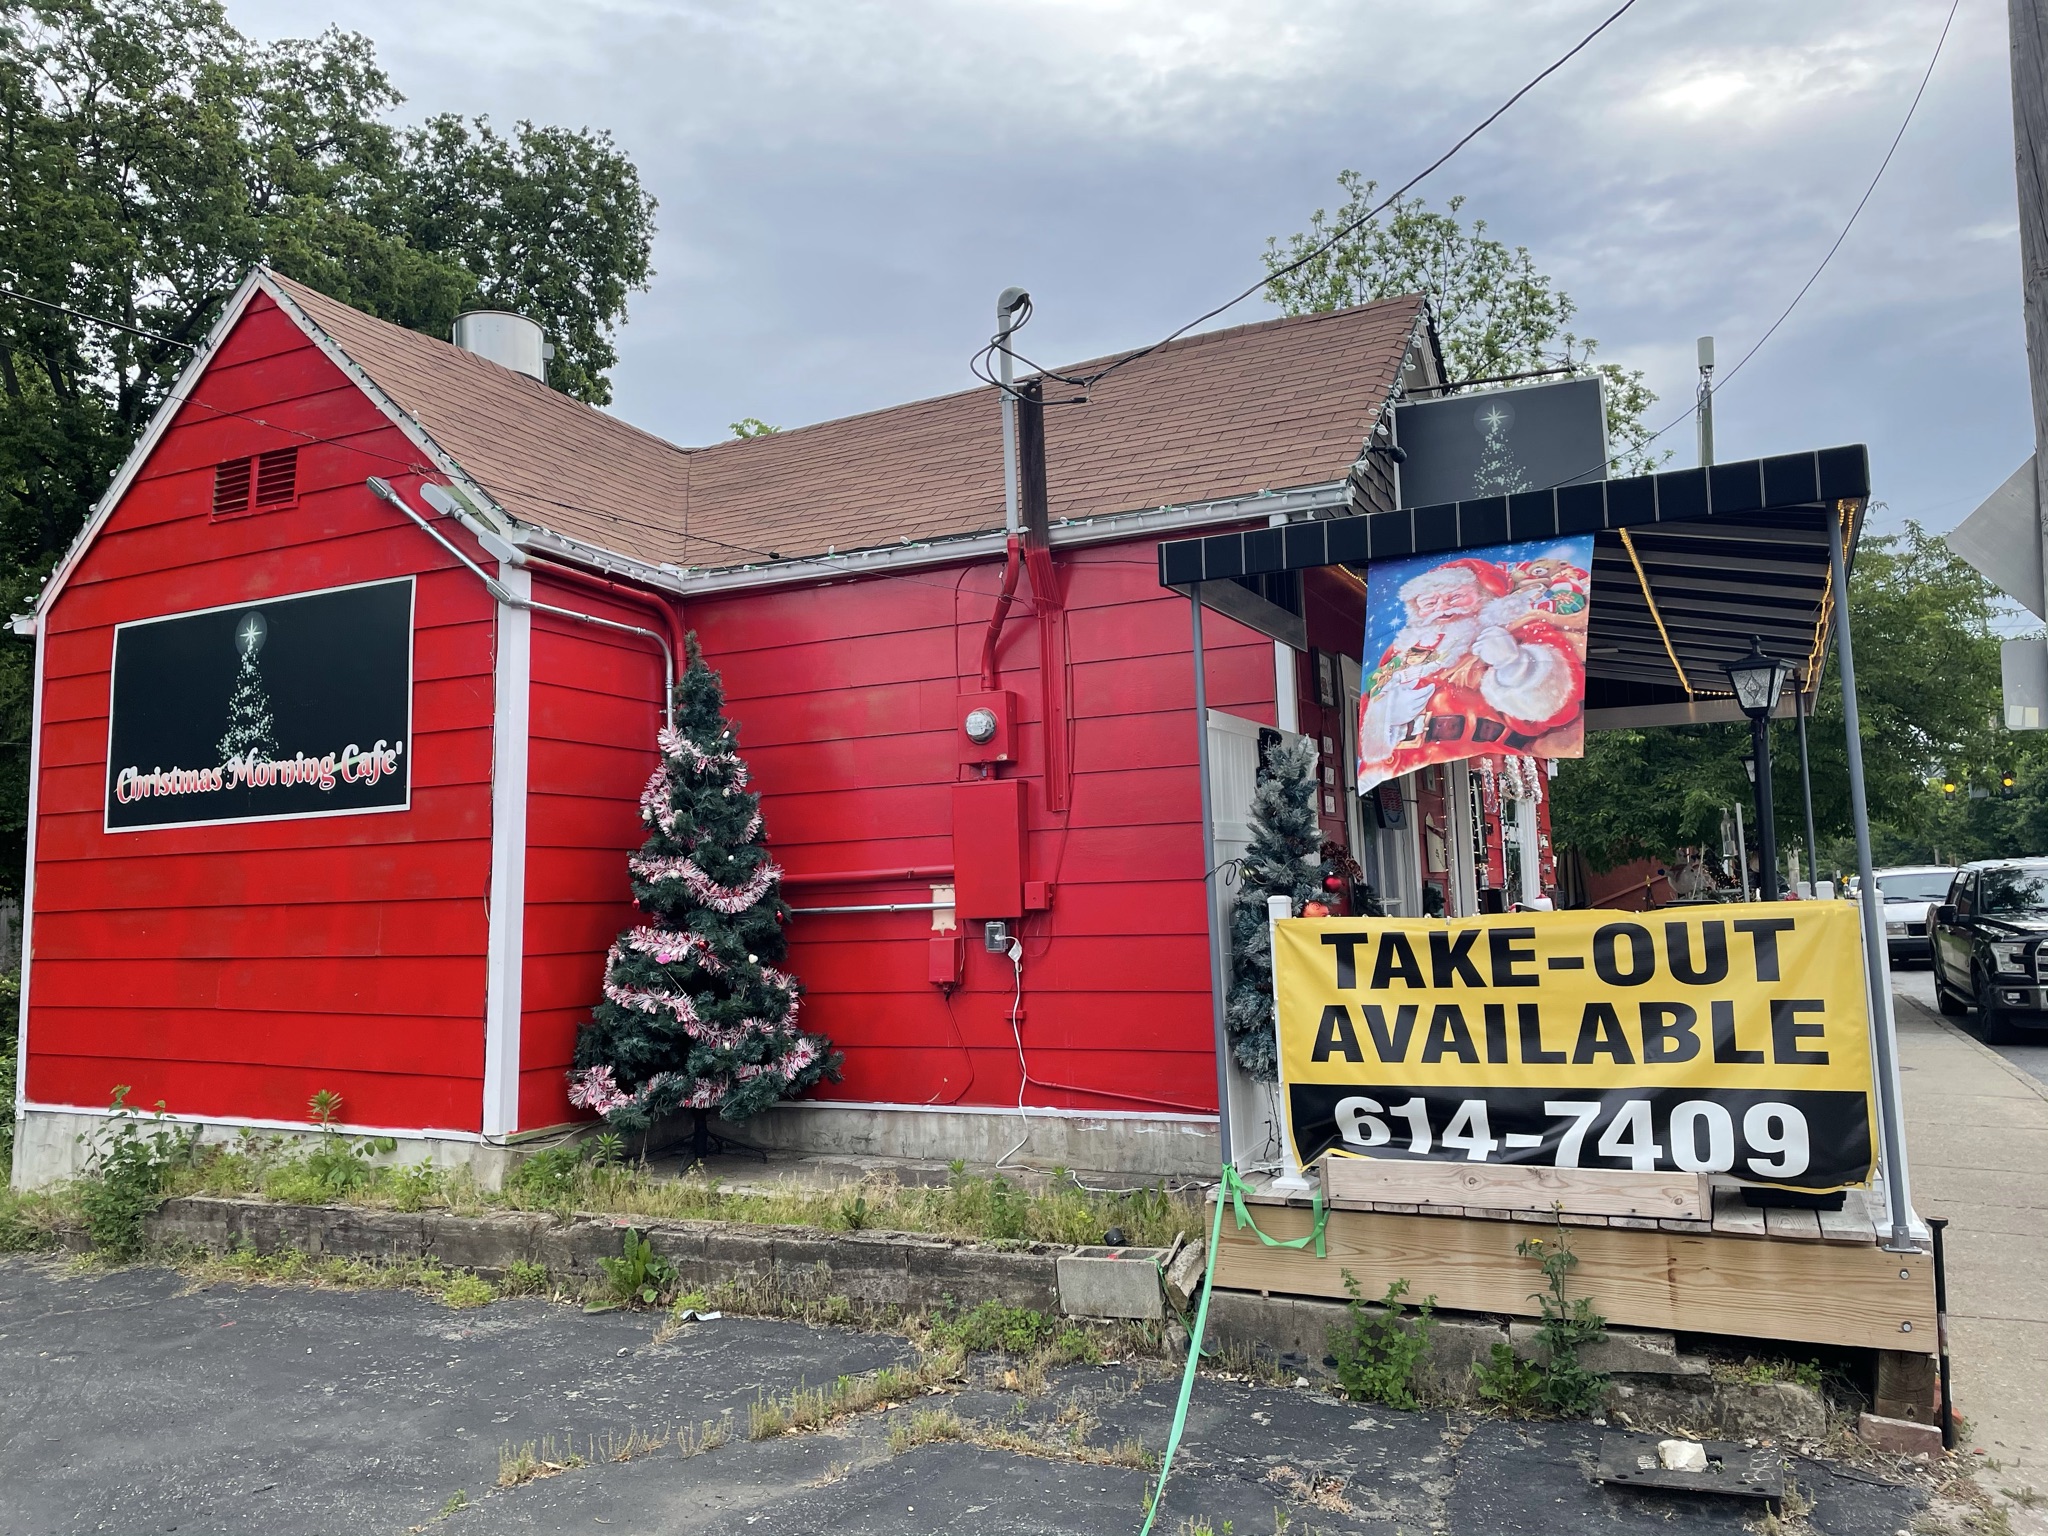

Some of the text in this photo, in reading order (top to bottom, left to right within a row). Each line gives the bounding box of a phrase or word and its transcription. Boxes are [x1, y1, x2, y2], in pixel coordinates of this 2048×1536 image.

[116, 765, 222, 804] Christmas
[226, 747, 336, 791] Morning
[1321, 917, 1796, 990] TAKE-OUT
[1310, 999, 1830, 1066] AVAILABLE
[1334, 1096, 1810, 1178] 614-7409
